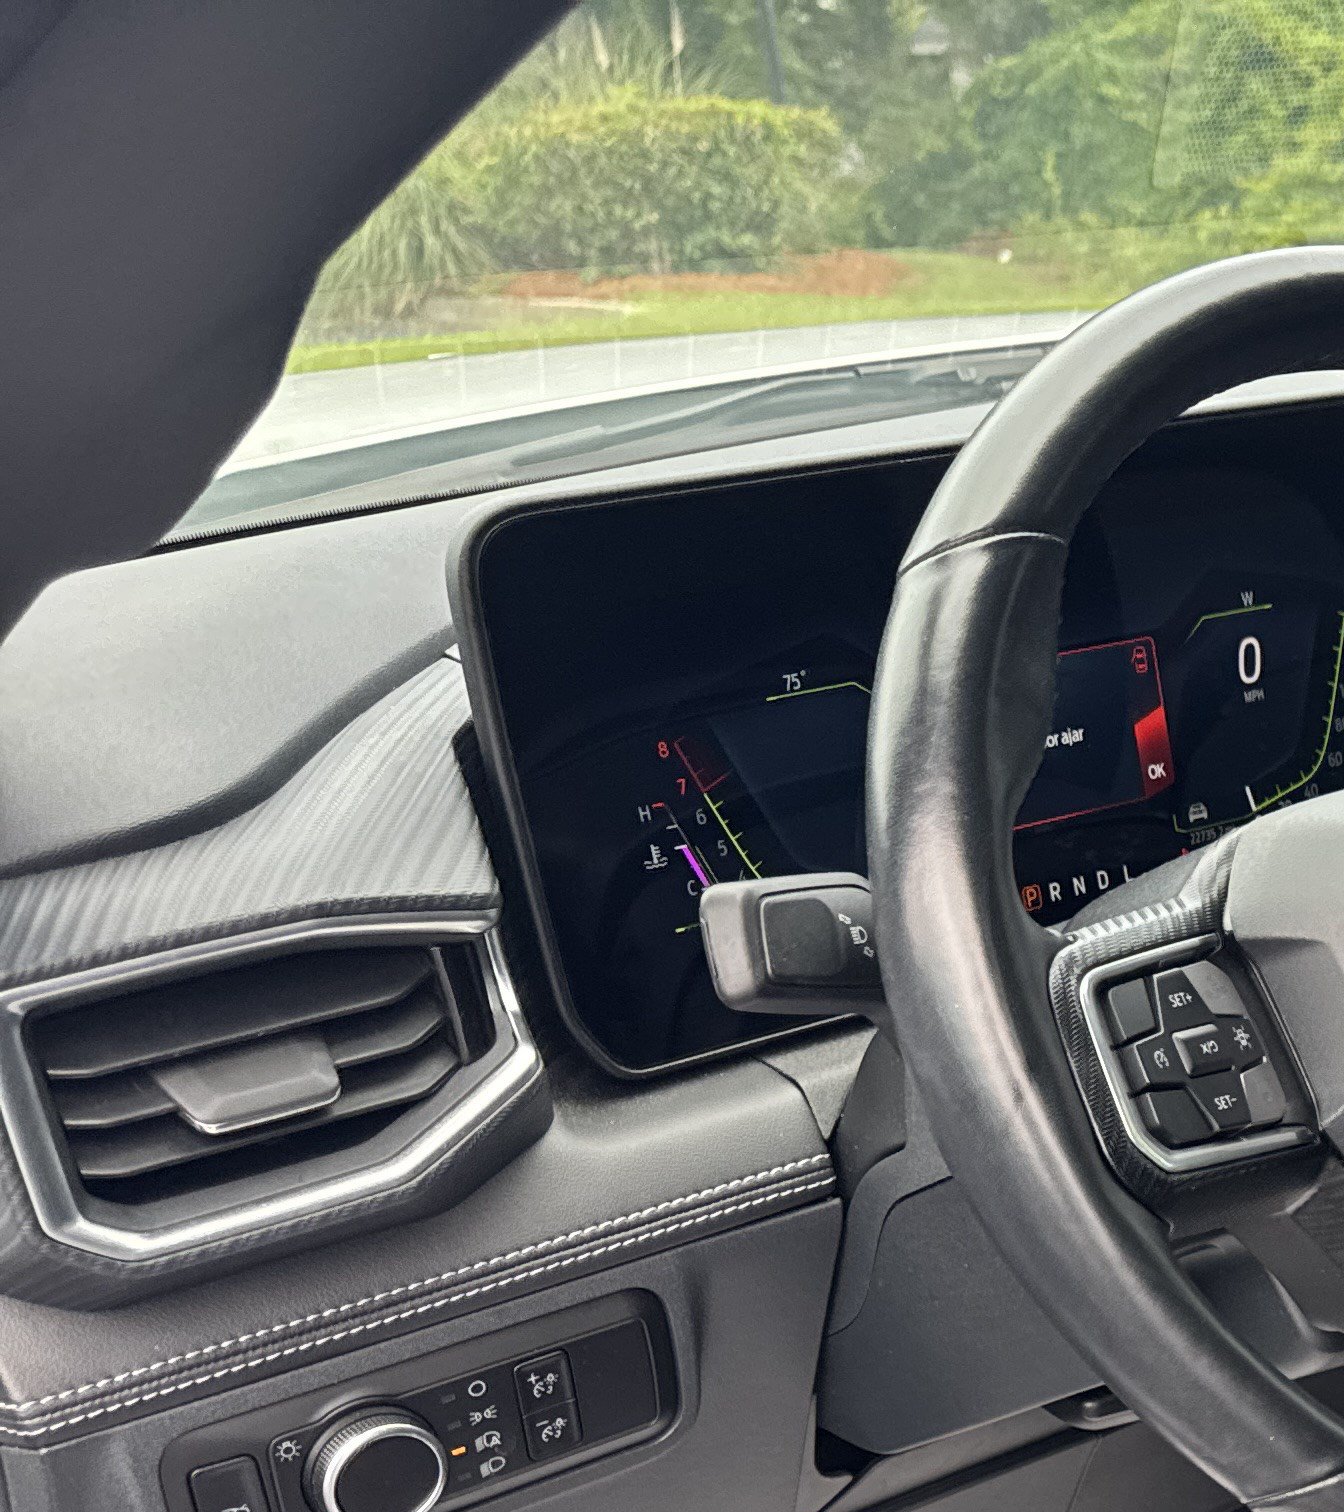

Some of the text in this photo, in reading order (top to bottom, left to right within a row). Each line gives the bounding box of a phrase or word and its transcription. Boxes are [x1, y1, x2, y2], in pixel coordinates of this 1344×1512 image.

[1240, 591, 1254, 606] W
[1238, 636, 1262, 684] 0
[782, 670, 807, 691] 75°
[1044, 727, 1085, 748] or ajar
[657, 741, 669, 758] 8
[1328, 752, 1343, 768] 60
[1148, 763, 1167, 780] OK
[676, 778, 686, 795] 7
[637, 805, 652, 823] H
[695, 808, 708, 825] 6
[717, 840, 728, 857] 5
[687, 879, 699, 896] C
[1049, 883, 1062, 902] R
[1072, 876, 1087, 896] N
[1096, 870, 1109, 889] D
[1123, 864, 1133, 882] L
